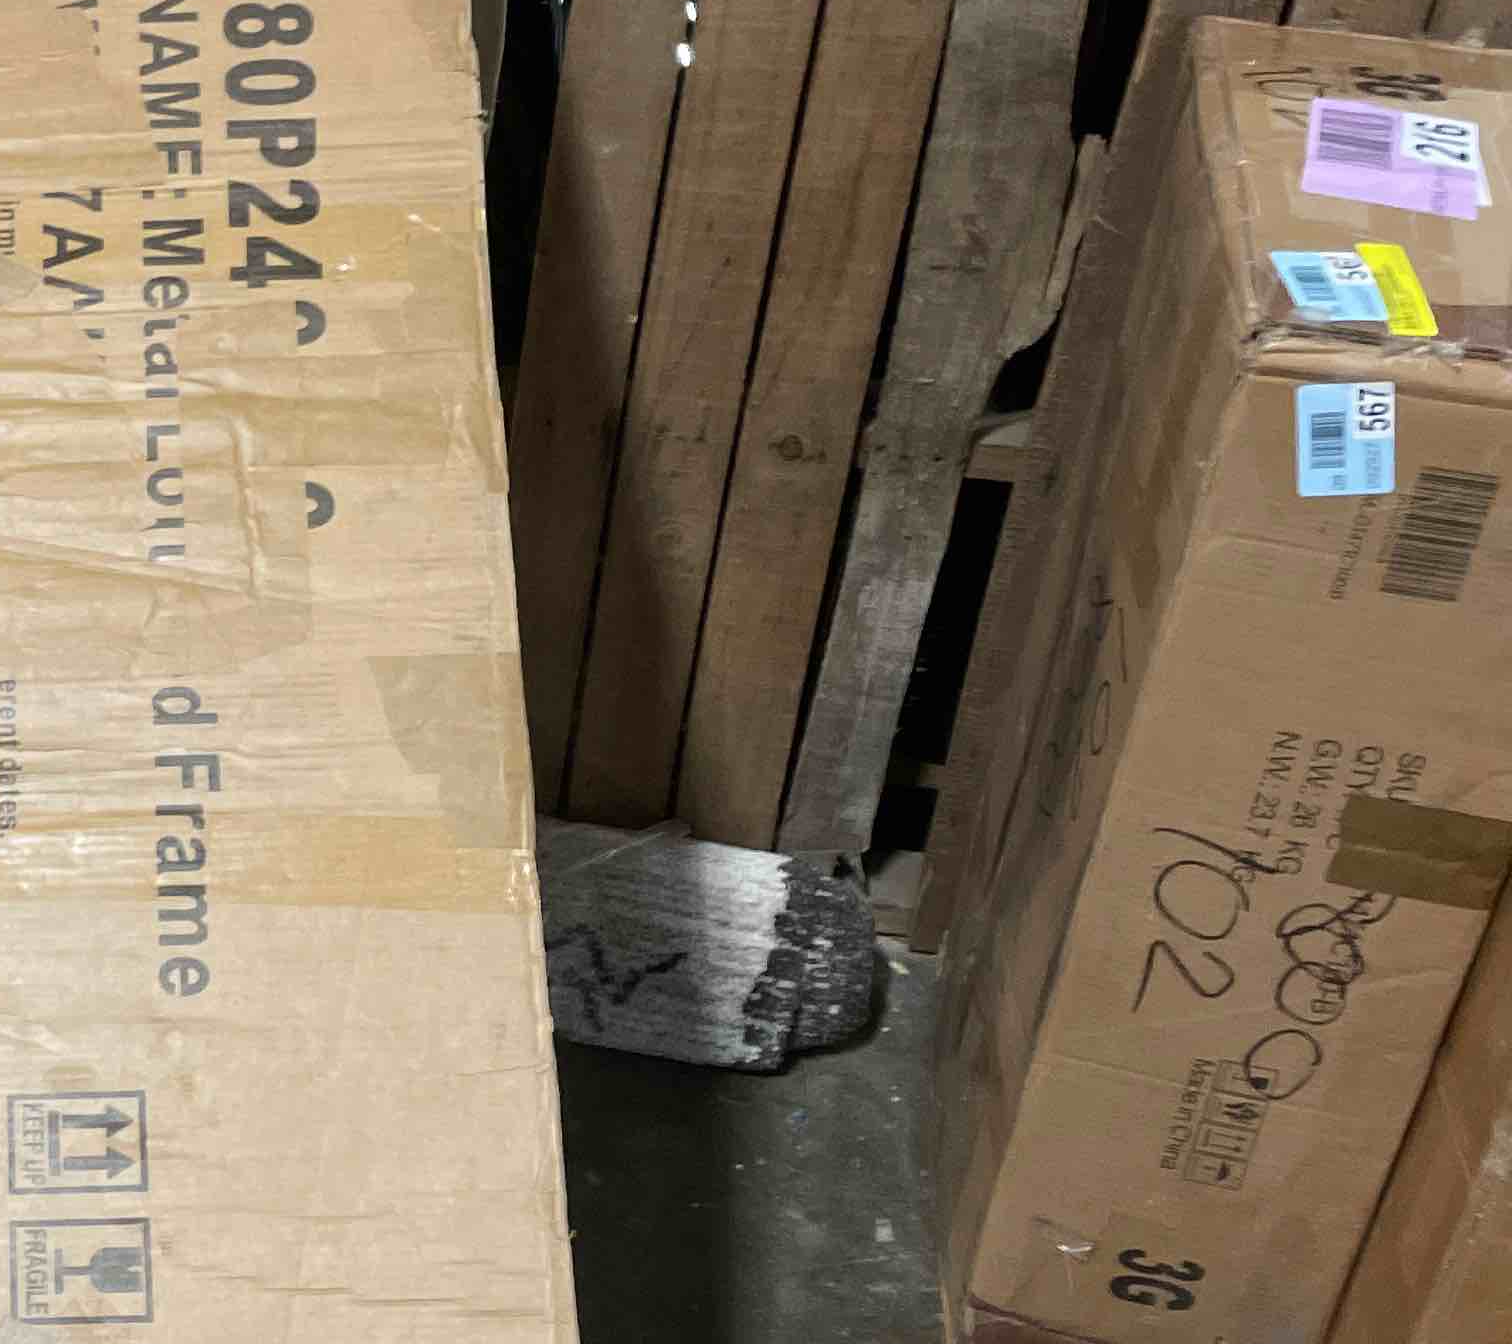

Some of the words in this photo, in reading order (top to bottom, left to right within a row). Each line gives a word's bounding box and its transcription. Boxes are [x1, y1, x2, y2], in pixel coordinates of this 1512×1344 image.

[1358, 389, 1390, 432] 567
[1246, 792, 1280, 840] 23.7
[154, 754, 221, 998] Frame
[1276, 839, 1310, 875] KG
[1180, 1057, 1216, 1104] Made
[22, 1102, 45, 1152] KEEP
[1173, 1106, 1195, 1121] in
[1159, 1122, 1195, 1170] China
[24, 1158, 47, 1185] UP
[23, 1228, 49, 1316] FRAGILE
[1110, 1249, 1206, 1311] 3G
